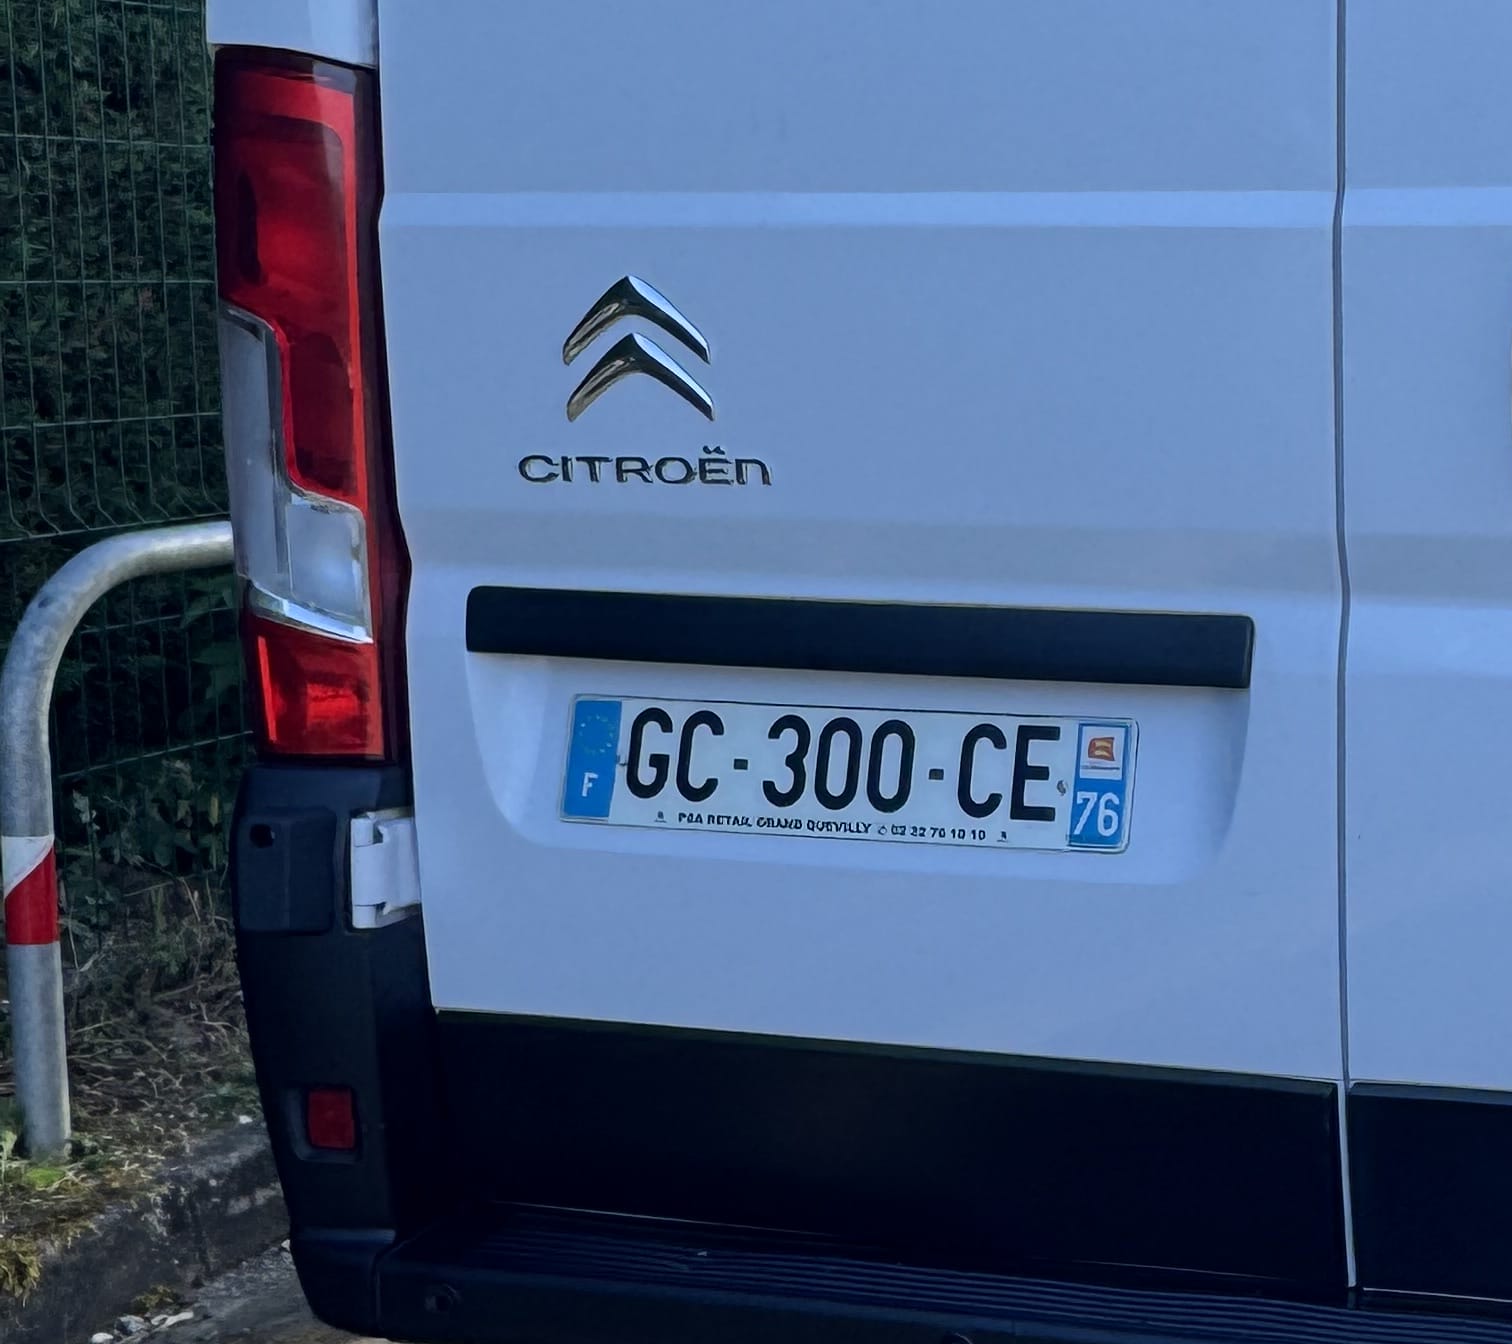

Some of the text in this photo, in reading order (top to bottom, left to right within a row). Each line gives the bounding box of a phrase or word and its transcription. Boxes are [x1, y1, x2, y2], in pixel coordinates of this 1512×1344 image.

[625, 707, 1061, 823] GC-300-CE
[579, 771, 598, 798] F
[1073, 791, 1120, 837] 76
[930, 827, 946, 839] 70
[951, 829, 966, 840] 10
[971, 830, 986, 842] 10
